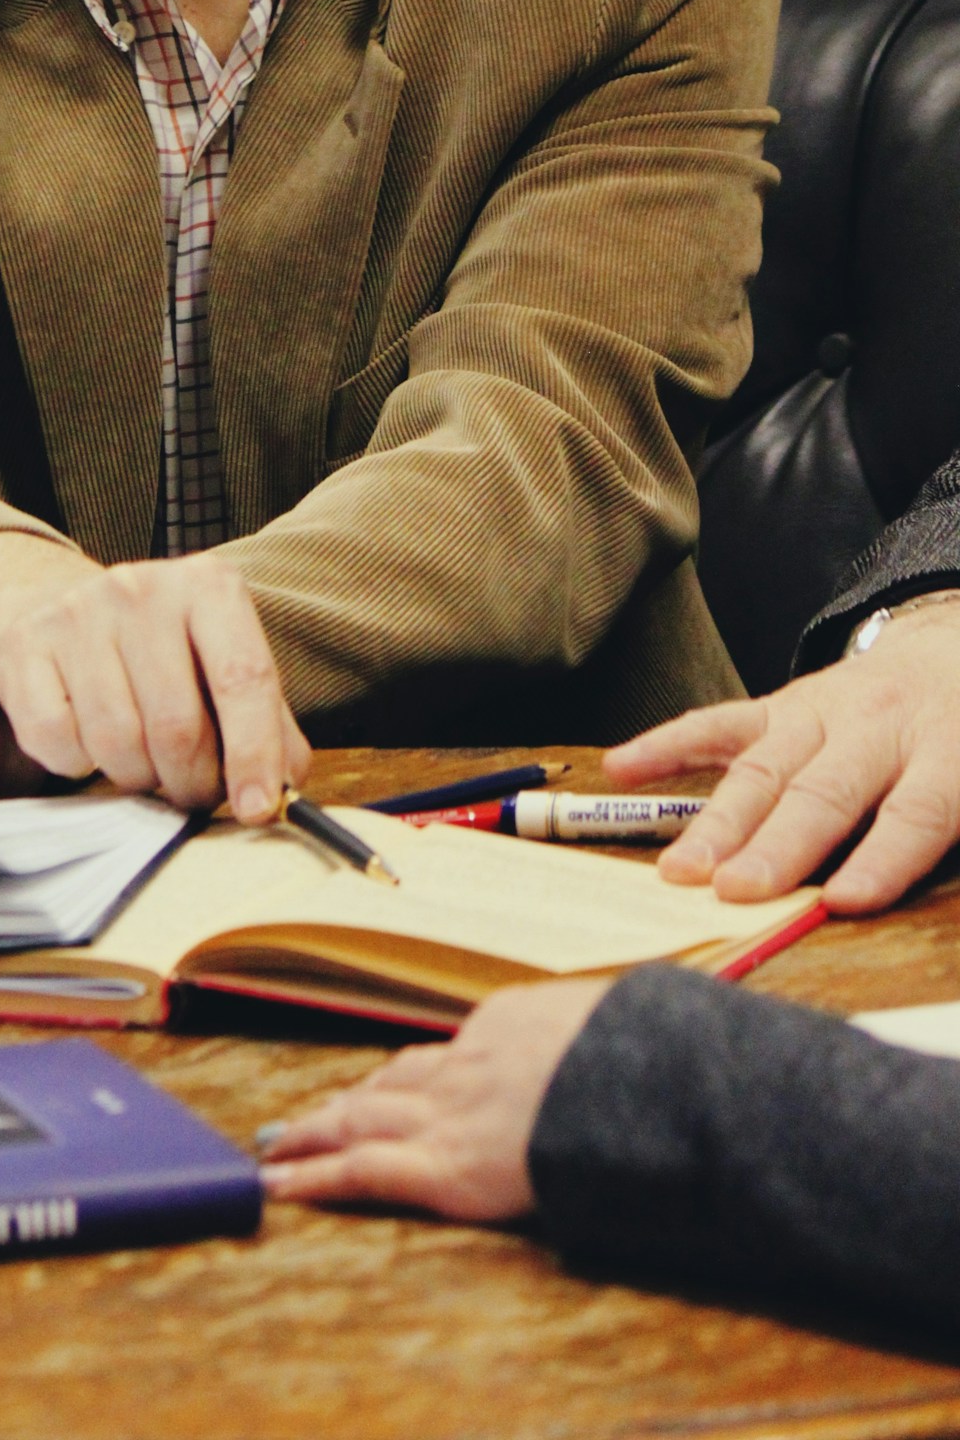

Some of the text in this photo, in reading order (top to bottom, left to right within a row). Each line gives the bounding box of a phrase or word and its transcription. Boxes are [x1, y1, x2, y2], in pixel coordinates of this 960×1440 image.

[595, 802, 652, 811] MARKER
[568, 812, 652, 823] WHITE BOARD
